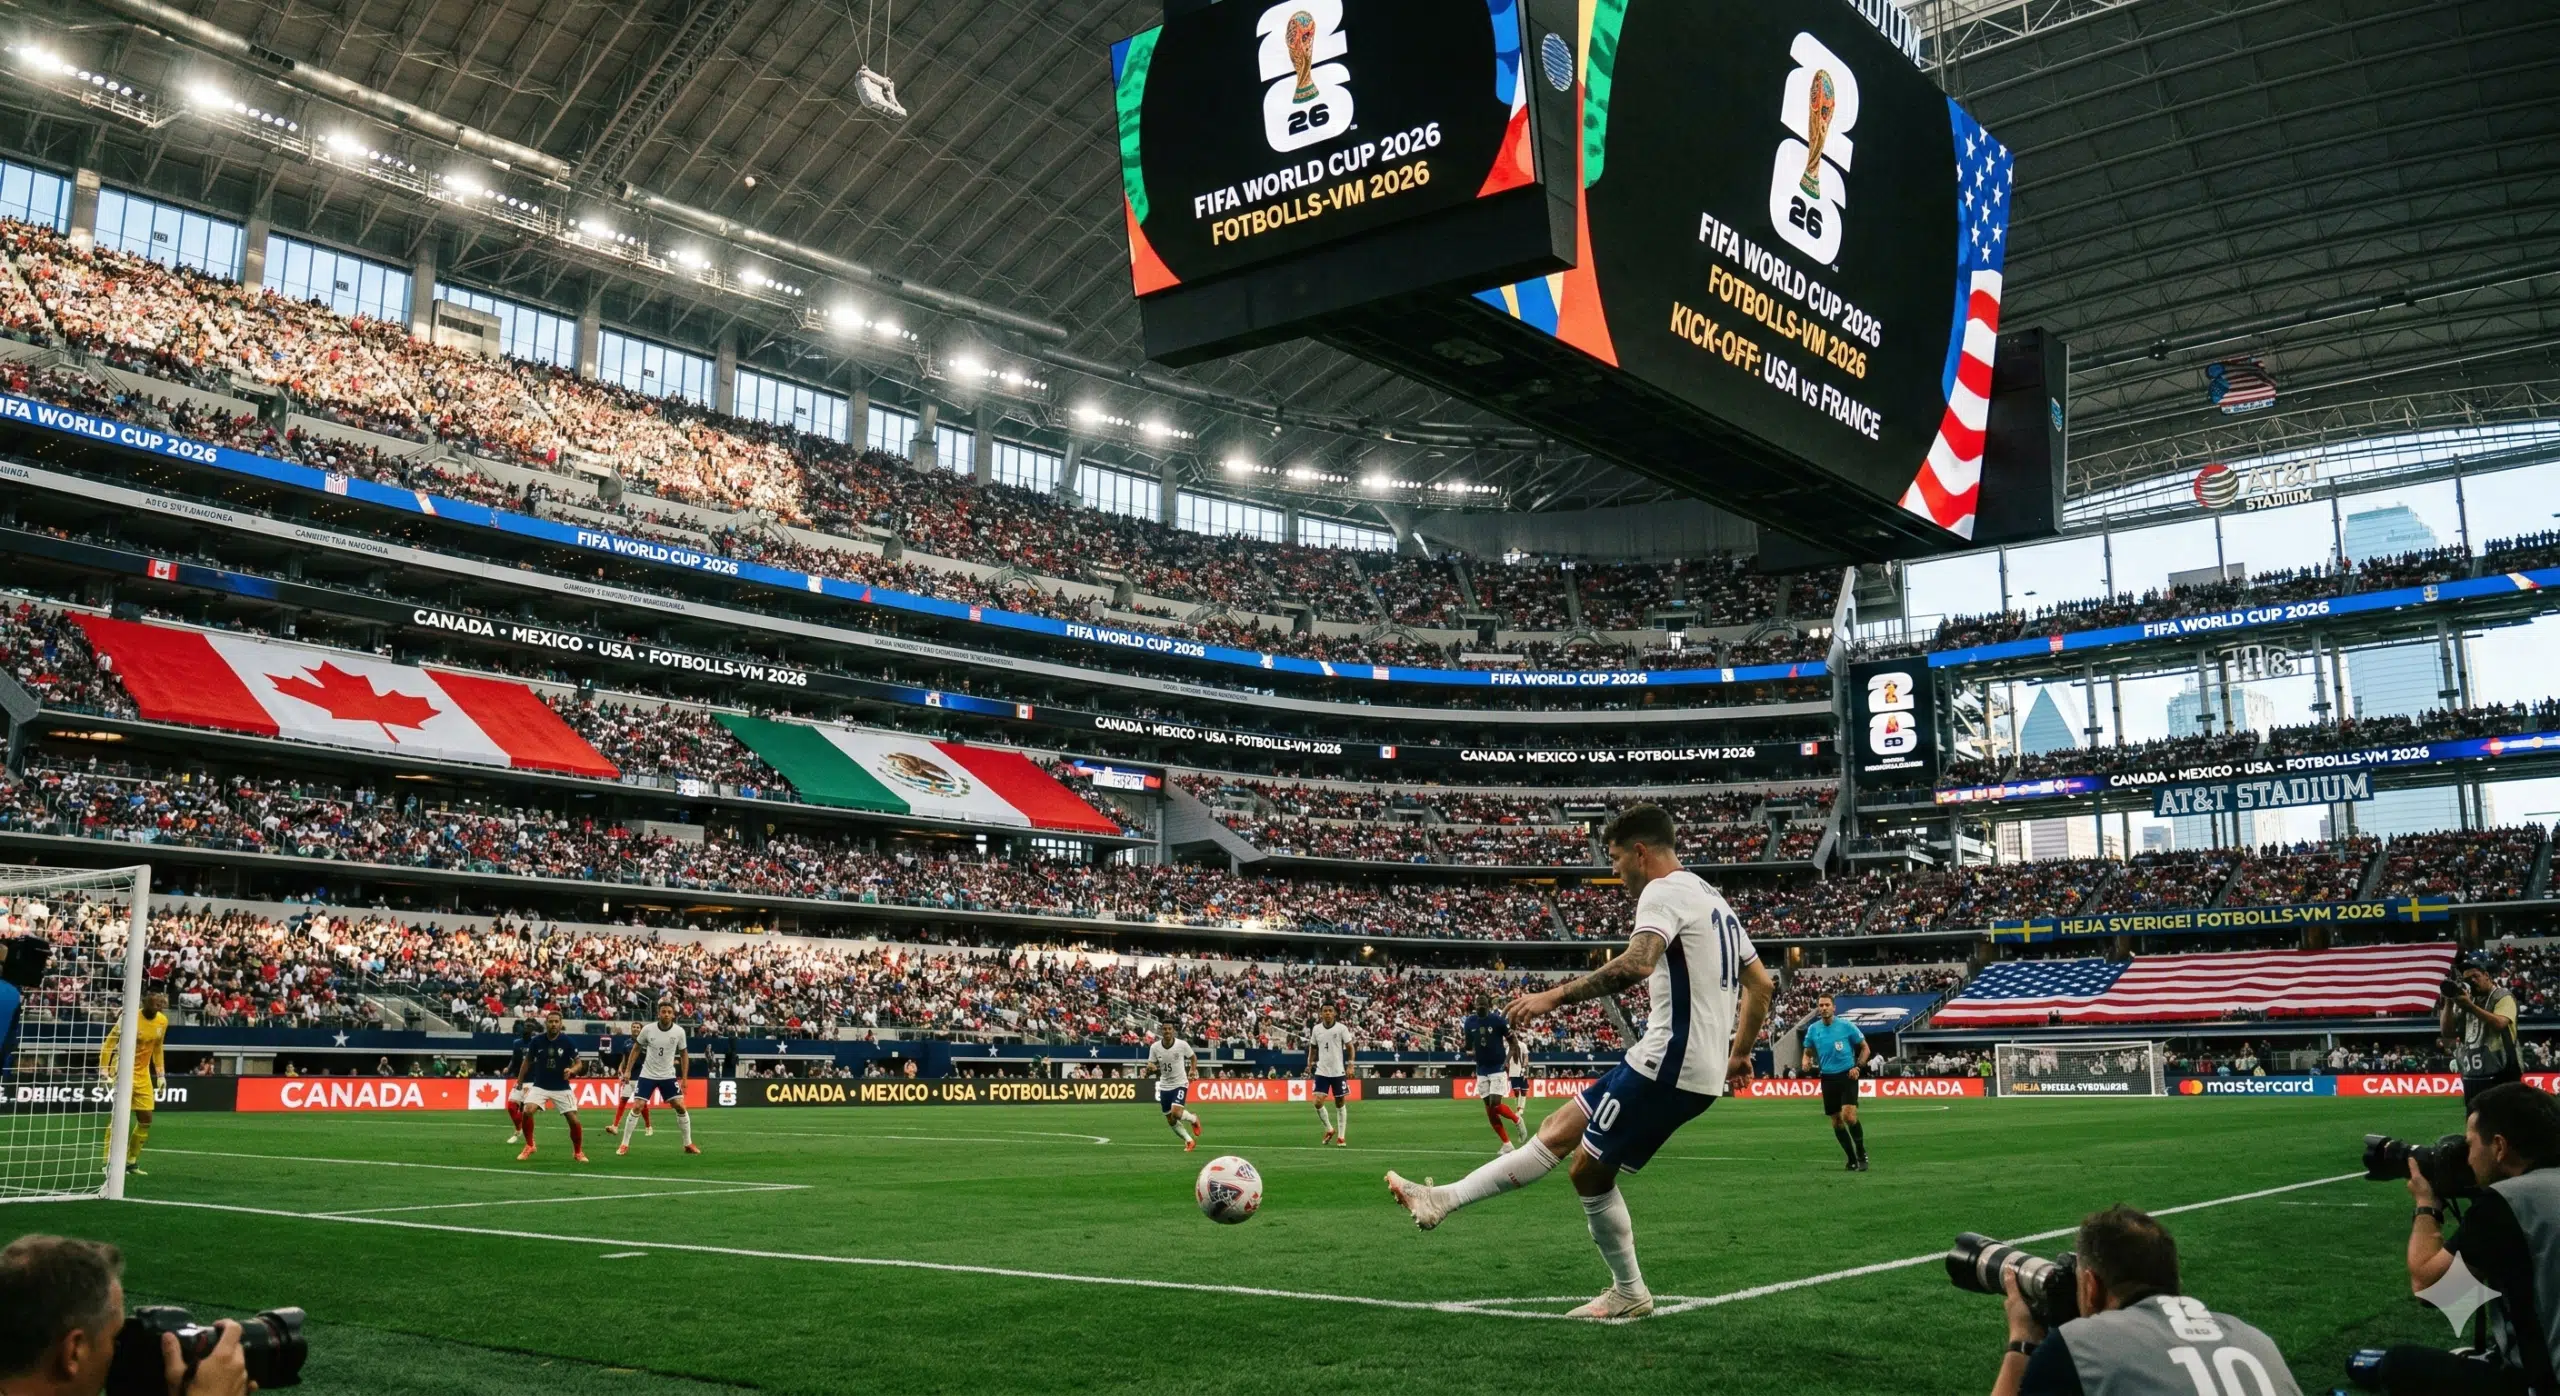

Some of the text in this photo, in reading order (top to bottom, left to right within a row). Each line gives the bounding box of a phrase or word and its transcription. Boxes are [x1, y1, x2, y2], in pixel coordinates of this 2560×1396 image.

[1287, 103, 1330, 136] 26
[1194, 121, 1441, 219] FIFA WORLD CUP 2026
[1212, 160, 1430, 245] FOTBOLLS-VM 2026
[1789, 195, 1823, 240] 26
[1699, 212, 1881, 348] FIFA WORLD CUP 2026
[1709, 264, 1867, 379] FOTBOLLS-VM 2026
[1670, 301, 1761, 377] KICK-OFF:
[1764, 352, 1797, 396] USA
[1820, 383, 1881, 440] FRANCE
[36, 406, 116, 439] WORLD
[120, 428, 163, 450] CUP
[166, 438, 217, 463] 2026
[2245, 458, 2321, 495] AT&T
[2246, 489, 2313, 511] STADIUM
[577, 531, 739, 575] FIFA WORLD CUP 2026
[2144, 601, 2330, 638] FIFA WORLD CUP 2026
[413, 609, 807, 687] CANADA MEXICO USA FOTBOLLS-VM 2026
[1066, 624, 1205, 658] FIFA WORLD CUP 2026
[1490, 672, 1648, 686] FIFA WORLD CUP 2026
[1095, 716, 1342, 755] CANADA MEXICO USA FOTBOLLS-VM 2026
[1460, 747, 1755, 763] CANADA MEXICO USA FOTBOLLS-VM 2026
[2110, 746, 2430, 788] CANADA MEXICO USA FOTBOLLS-VM 2026
[2159, 772, 2369, 815] AT&T STADIUM
[2061, 903, 2386, 934] HEJA SVERIGE! FOTBOLLS-VM 2026
[1711, 907, 1740, 994] 10
[280, 1081, 424, 1108] CANADA
[766, 1082, 1136, 1103] CANADA MEXICO USA FOTBOLLS-VM 2026
[1197, 1082, 1268, 1100] CANADA
[1882, 1080, 1964, 1097] CANADA
[2206, 1076, 2314, 1093] mastercard
[2363, 1077, 2465, 1094] CANADA
[1593, 1091, 1621, 1132] 10
